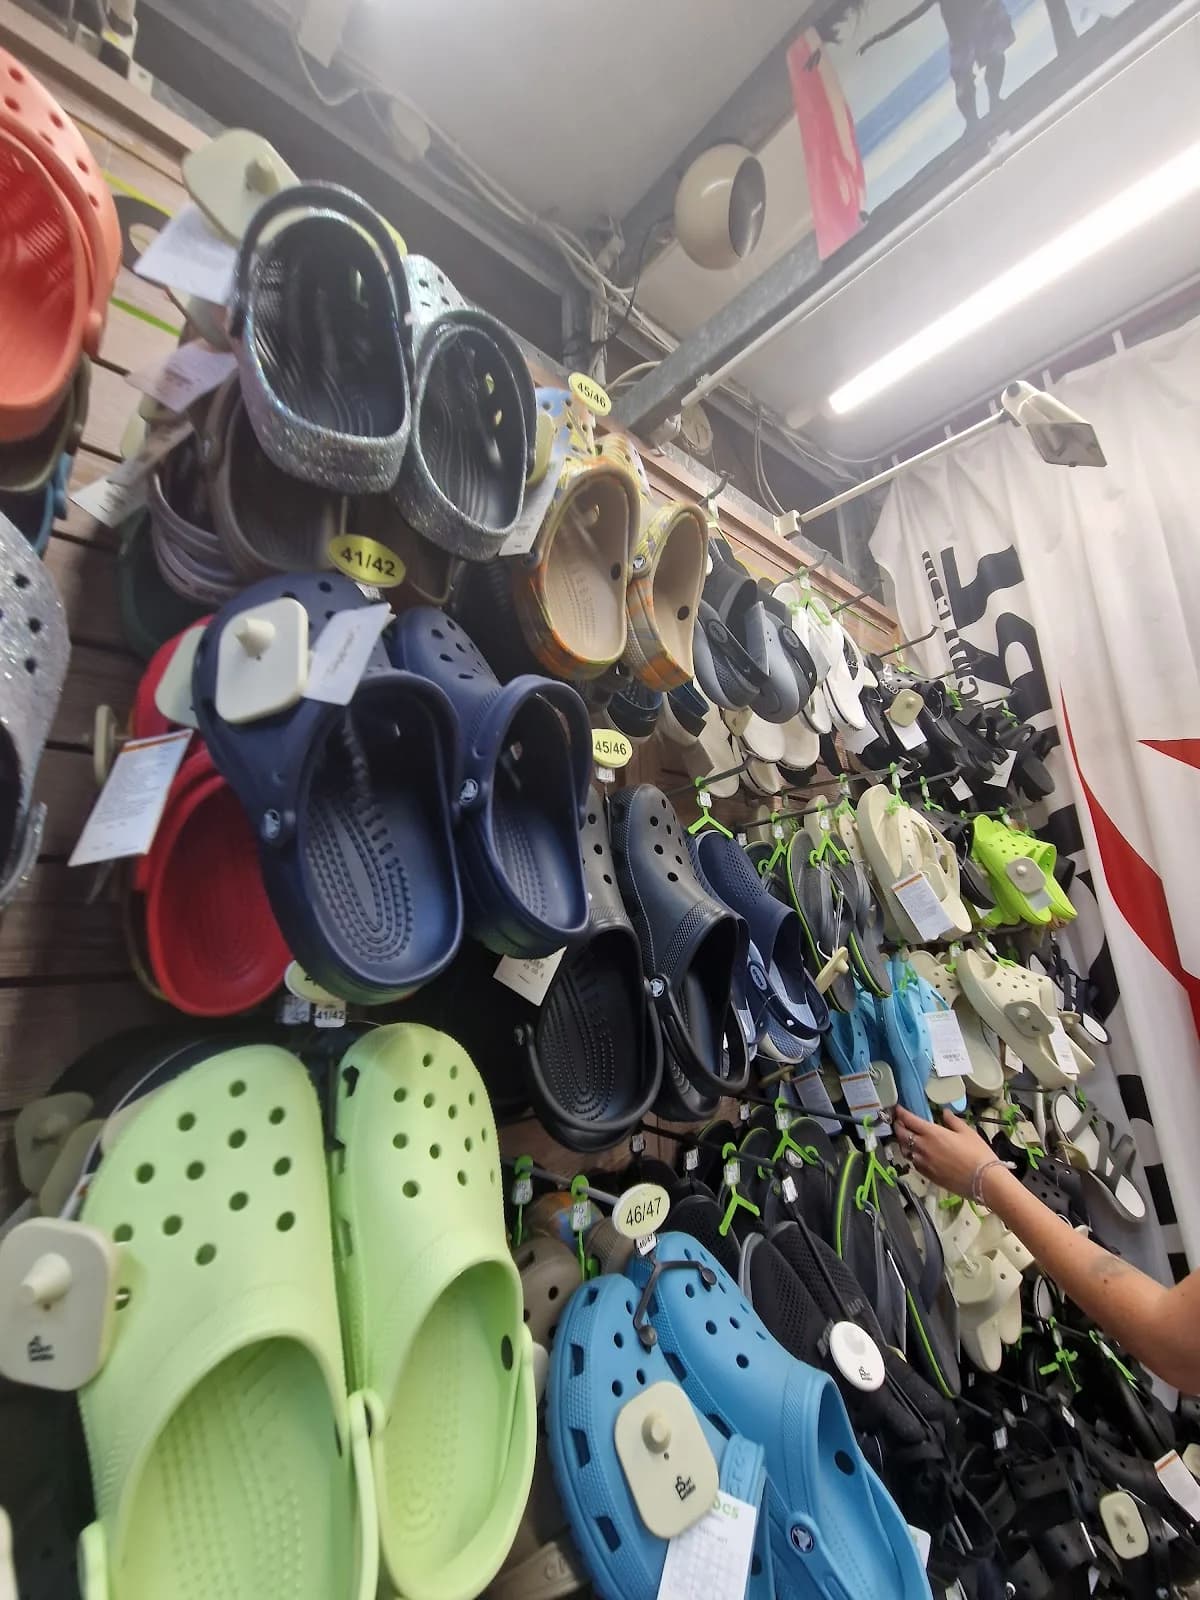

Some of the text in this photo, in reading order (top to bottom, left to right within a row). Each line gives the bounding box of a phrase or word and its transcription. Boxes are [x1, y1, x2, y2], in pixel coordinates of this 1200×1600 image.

[577, 382, 606, 408] 45/46
[341, 547, 396, 578] 41/42
[595, 740, 627, 755] 45/46
[626, 1197, 661, 1226] 46/47
